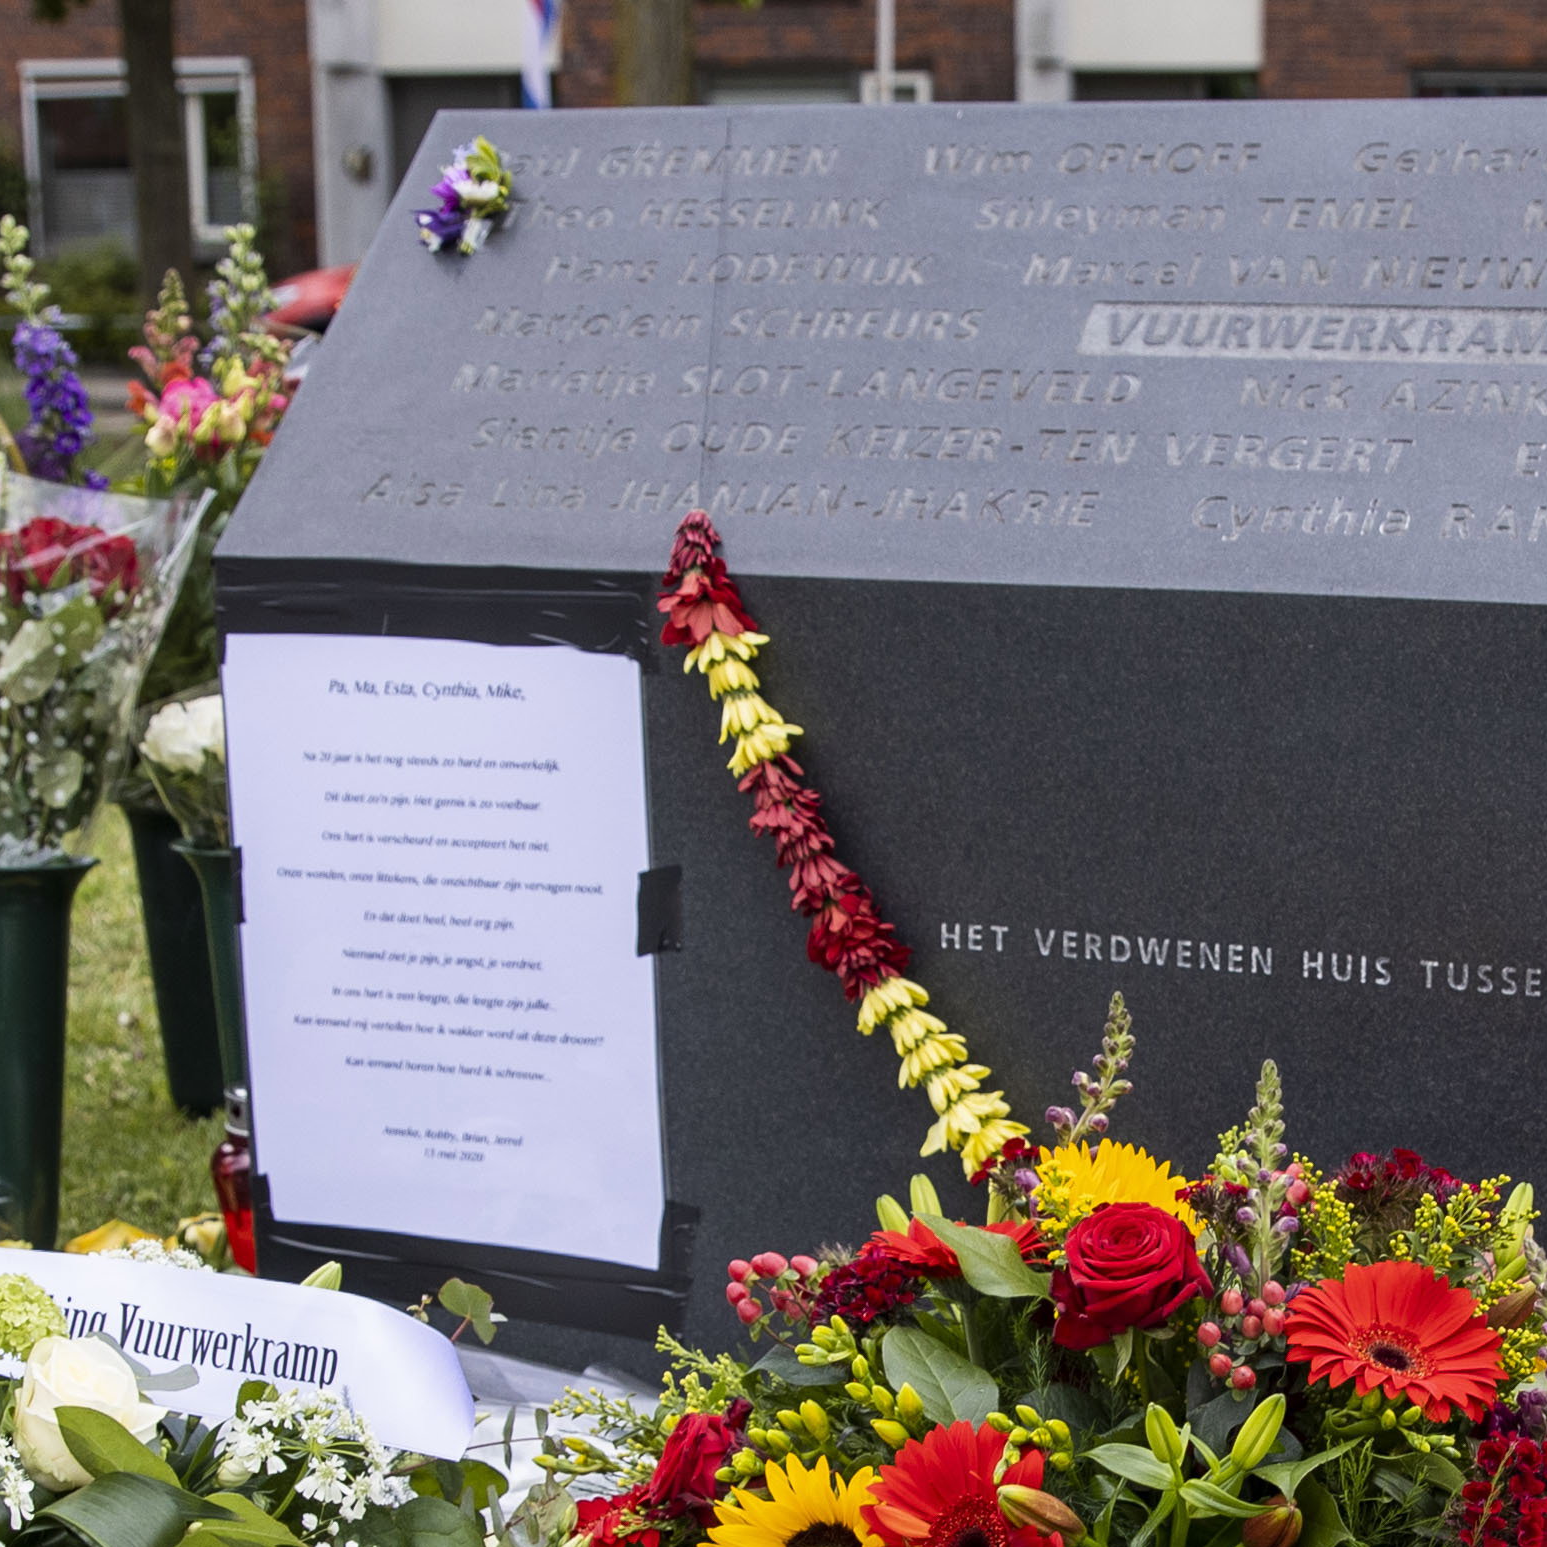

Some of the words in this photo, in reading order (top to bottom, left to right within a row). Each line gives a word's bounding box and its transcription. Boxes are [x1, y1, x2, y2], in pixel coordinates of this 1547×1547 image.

[501, 143, 582, 180] aul
[599, 142, 841, 179] GREMMEN
[923, 143, 1033, 176] Wim
[1055, 142, 1262, 174] OPHOFF
[639, 197, 892, 230] HESSELINK
[1257, 197, 1420, 231] TEMEL
[545, 254, 658, 286] Hans
[678, 252, 931, 287] LODEWIJK
[1022, 252, 1203, 287] Marcel
[1229, 253, 1338, 289] VAN
[471, 305, 703, 343] Marjolein
[721, 306, 985, 342] SCHREURS
[451, 360, 657, 400] Marietje
[675, 364, 1142, 405] SLOT-LANGEVELD
[1240, 373, 1356, 409] Nick
[470, 416, 638, 458] Sientje
[660, 420, 806, 454] OUDE
[1166, 432, 1416, 474] VERGERT
[489, 477, 585, 510] Lina
[609, 479, 1100, 527] JHANJAN-JHAKRIE
[1191, 494, 1412, 541] Cynthia
[384, 681, 417, 696] Esta,
[422, 682, 480, 700] Cynthia,
[487, 683, 525, 700] Mike,
[344, 832, 364, 842] hart
[378, 835, 433, 846] verscheurd
[509, 840, 526, 850] het
[940, 922, 1009, 953] HET
[1034, 927, 1273, 976] VERDWENEN
[1302, 949, 1392, 986] HUIS
[118, 1301, 340, 1391] Vuurwerkramp
